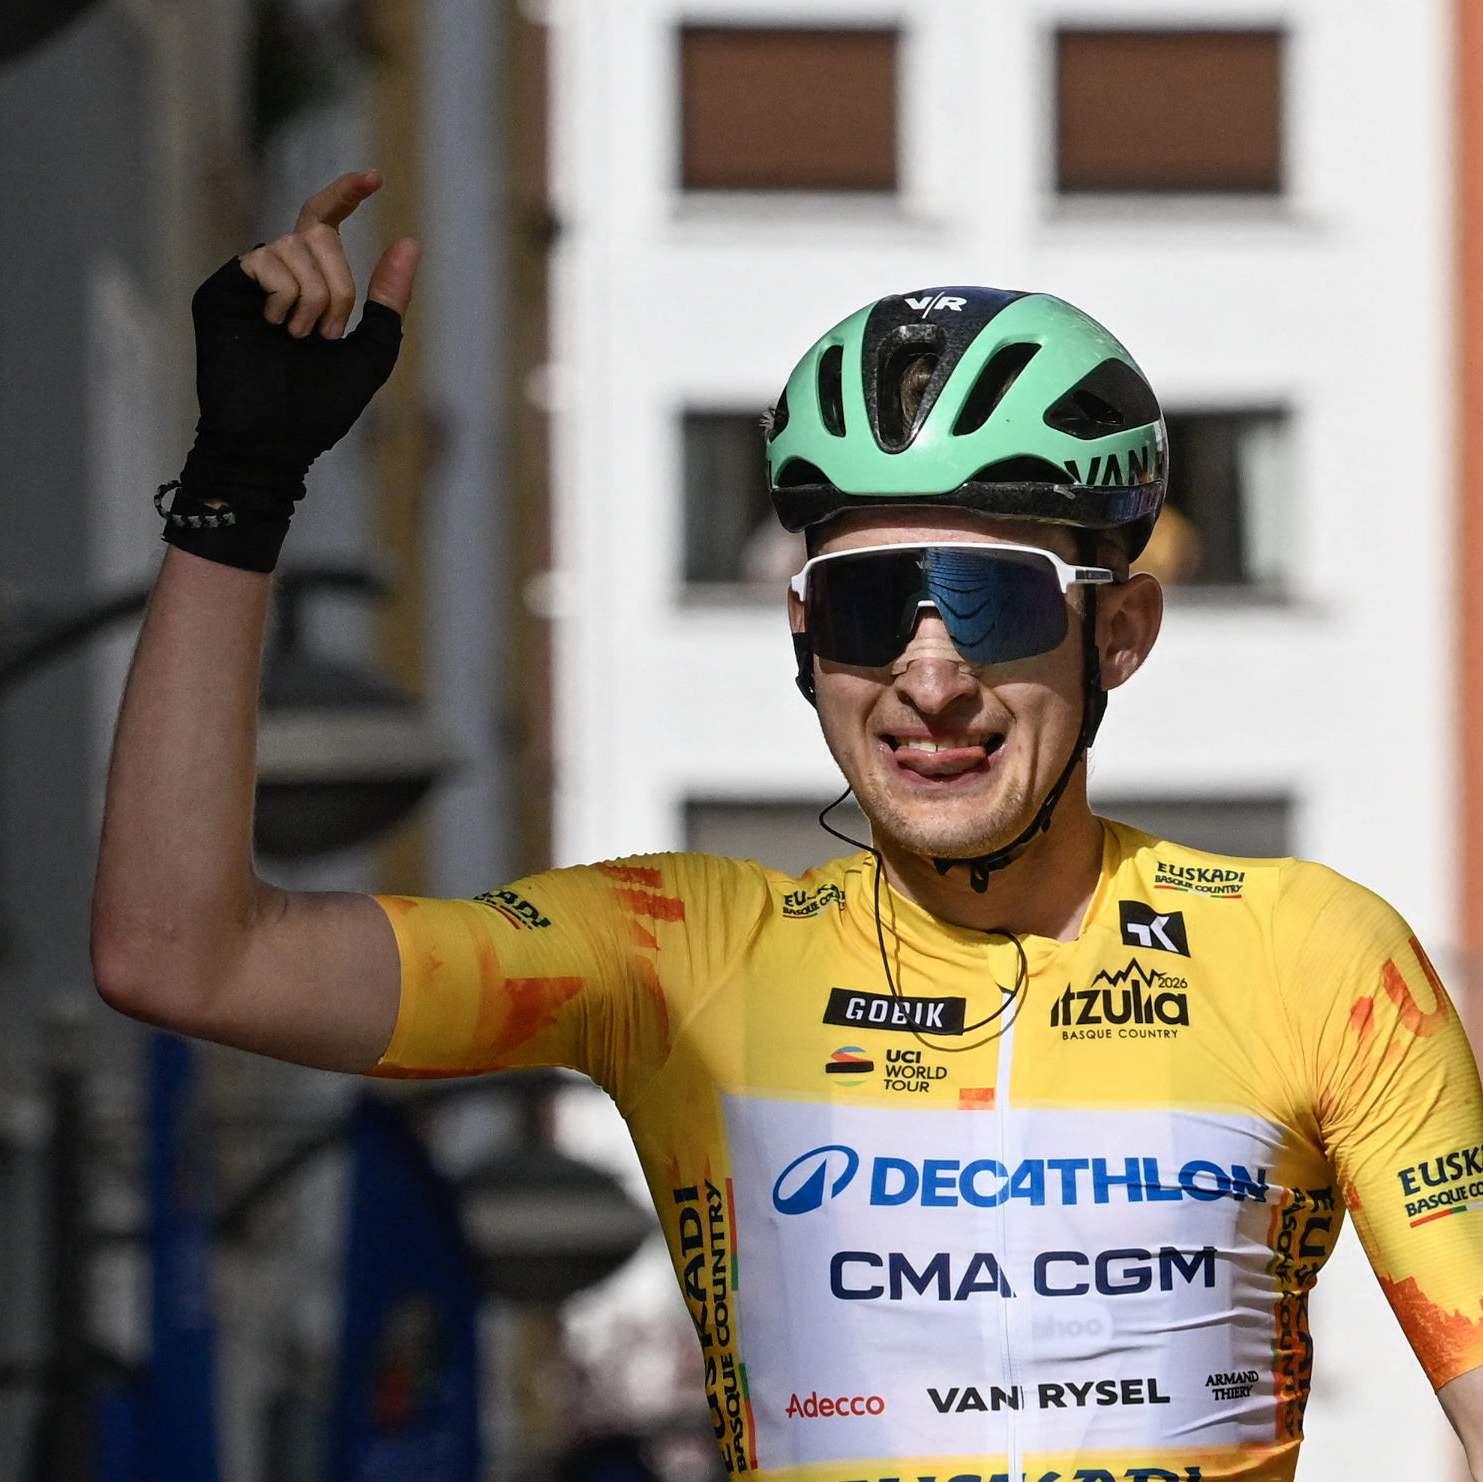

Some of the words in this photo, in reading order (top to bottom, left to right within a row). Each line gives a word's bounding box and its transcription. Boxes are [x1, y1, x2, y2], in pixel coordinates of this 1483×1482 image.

[1157, 861, 1246, 883] EUSKADI
[1155, 875, 1193, 890] BASQUE
[1195, 884, 1243, 894] COUNTRY
[1158, 977, 1188, 989] 2026
[846, 997, 946, 1028] GOBIK
[1062, 1029, 1112, 1040] BASQUE
[1118, 1029, 1179, 1039] COUNTRY
[886, 1049, 921, 1064] UCI
[886, 1065, 947, 1079] WORLD
[883, 1079, 929, 1093] TOUR
[869, 1156, 1270, 1208] DECATHLON
[1404, 1186, 1469, 1217] BASQUE
[704, 1179, 731, 1347] COUNTRY
[829, 1251, 1017, 1300] CMA
[1034, 1246, 1216, 1297] CGM
[1205, 1371, 1259, 1388] ARMAND
[926, 1386, 1024, 1413] VAN
[1038, 1378, 1170, 1408] RYSEL
[1212, 1385, 1254, 1401] THIERY
[721, 1353, 748, 1474] BASQUE
[785, 1391, 885, 1418] Adecco
